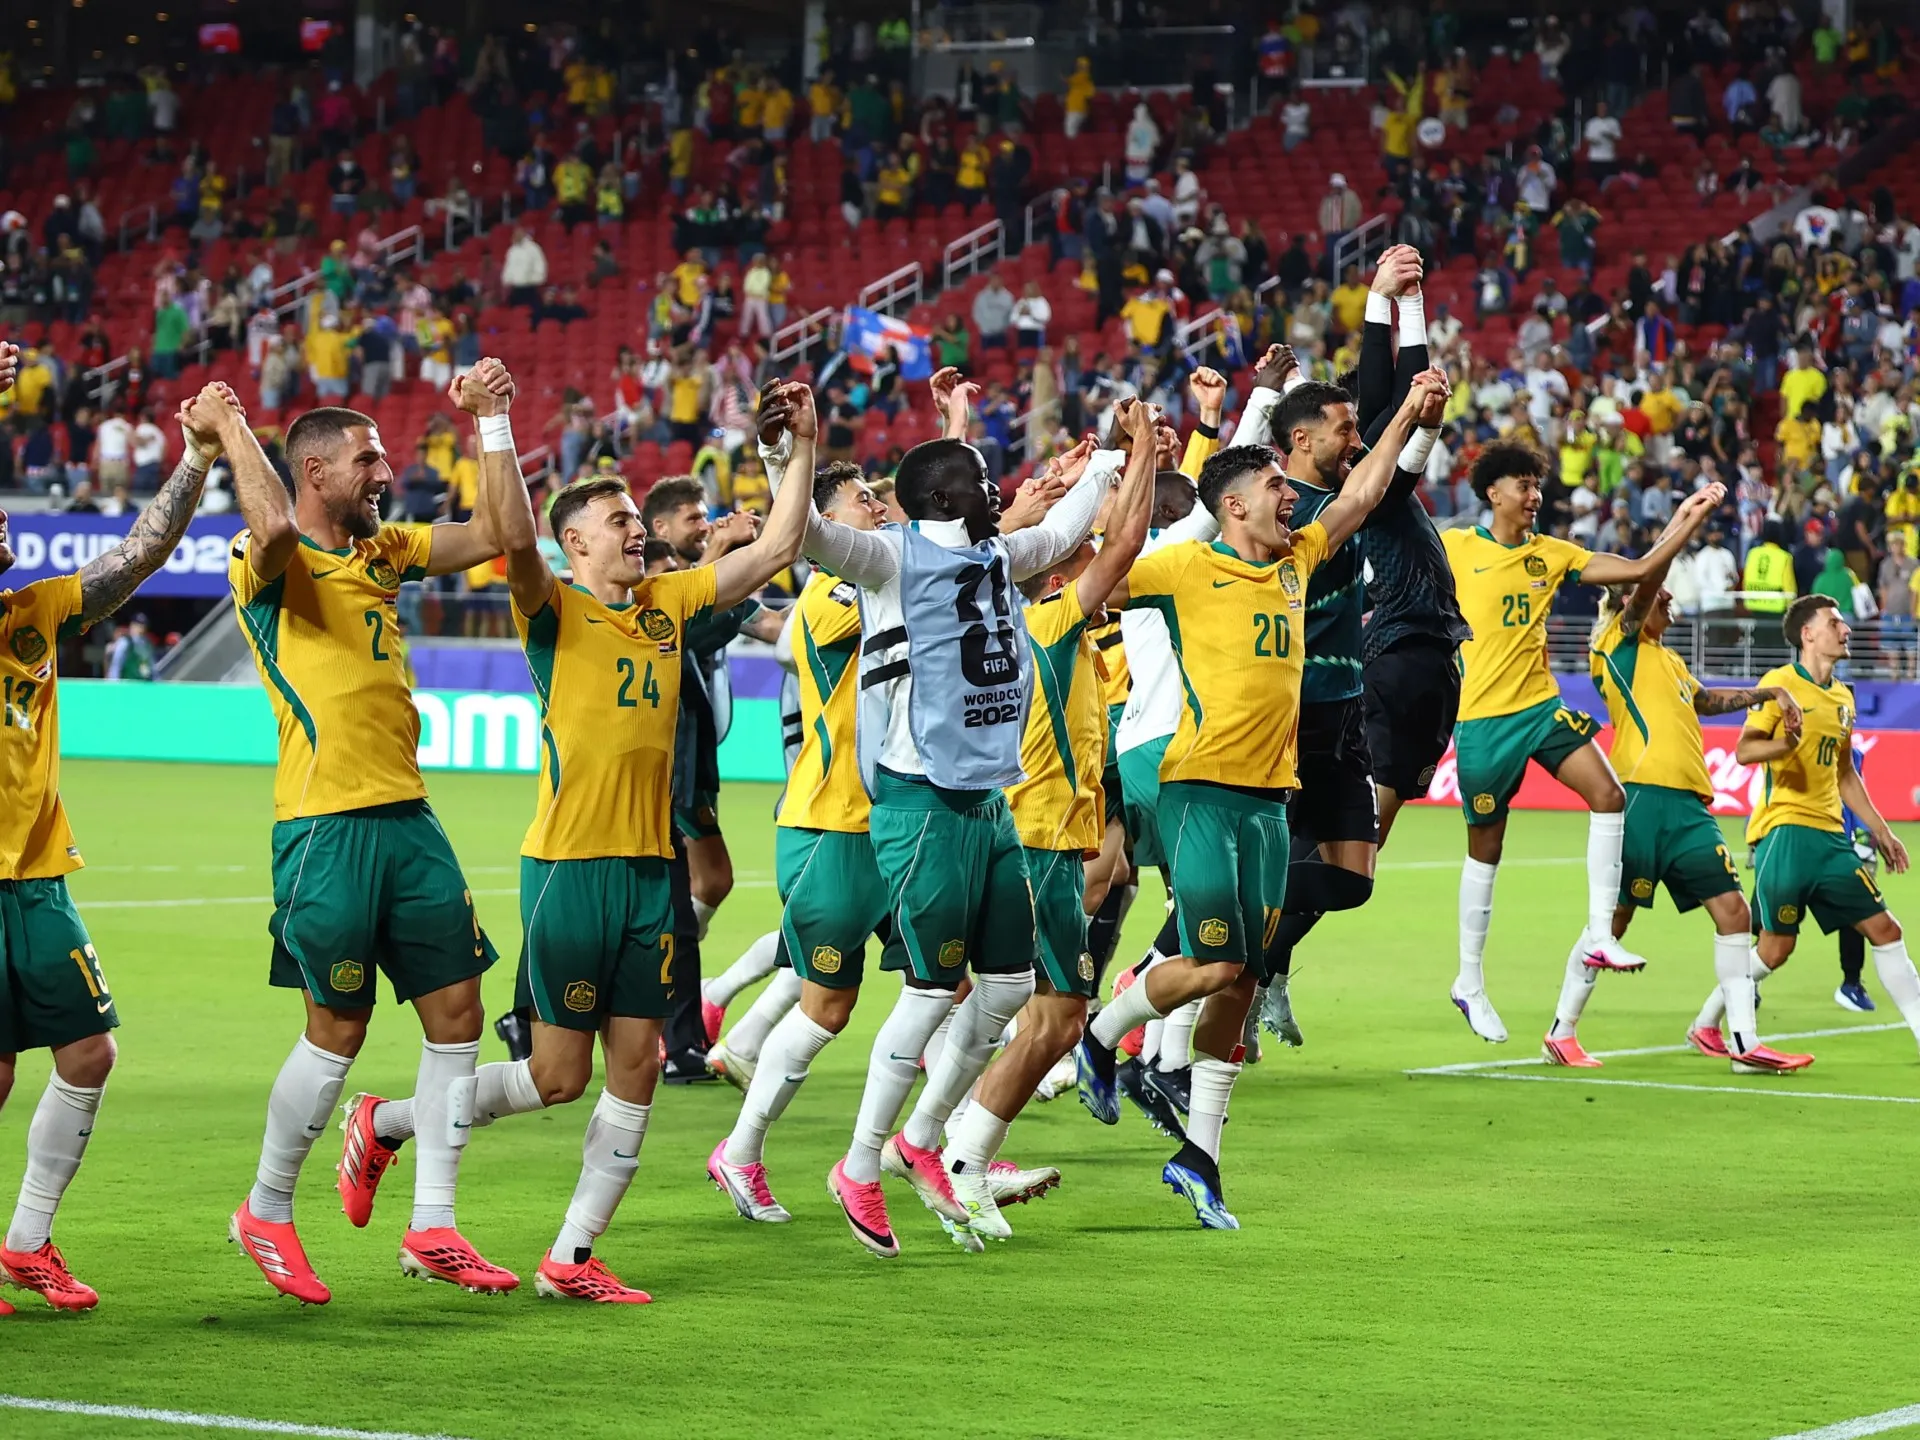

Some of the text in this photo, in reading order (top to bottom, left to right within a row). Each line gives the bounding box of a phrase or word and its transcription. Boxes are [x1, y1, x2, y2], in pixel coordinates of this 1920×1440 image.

[1502, 593, 1530, 627] 25
[364, 610, 389, 661] 2
[1253, 613, 1291, 658] 20
[617, 657, 660, 709] 24
[983, 657, 1010, 675] FIFA
[4, 675, 36, 728] 13
[964, 691, 1005, 707] WORLD
[1816, 735, 1837, 767] 10
[69, 944, 110, 998] 13
[660, 932, 674, 985] 2
